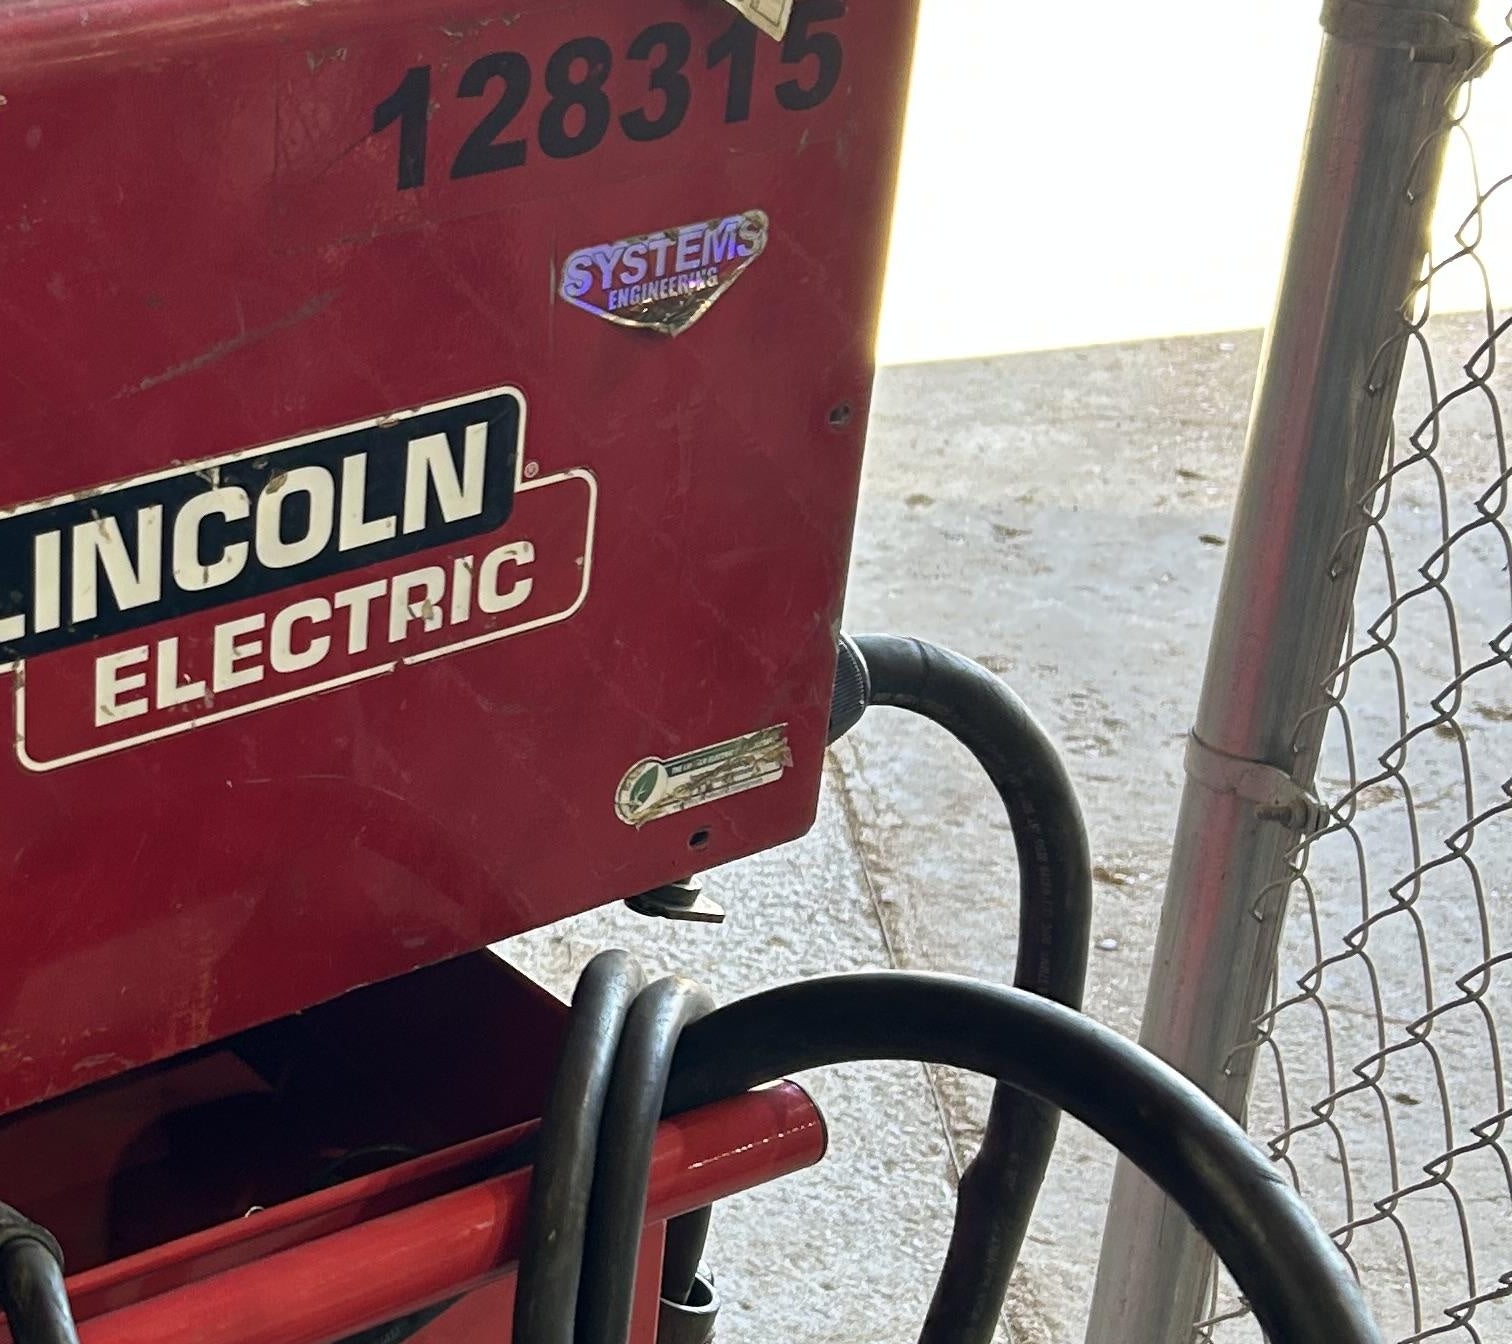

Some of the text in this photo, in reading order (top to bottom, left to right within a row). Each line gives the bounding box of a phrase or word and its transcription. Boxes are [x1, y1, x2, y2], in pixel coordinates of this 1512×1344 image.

[563, 215, 763, 298] SYSTEMS
[607, 266, 719, 311] ENGINEERING
[94, 540, 535, 728] ELECTRIC
